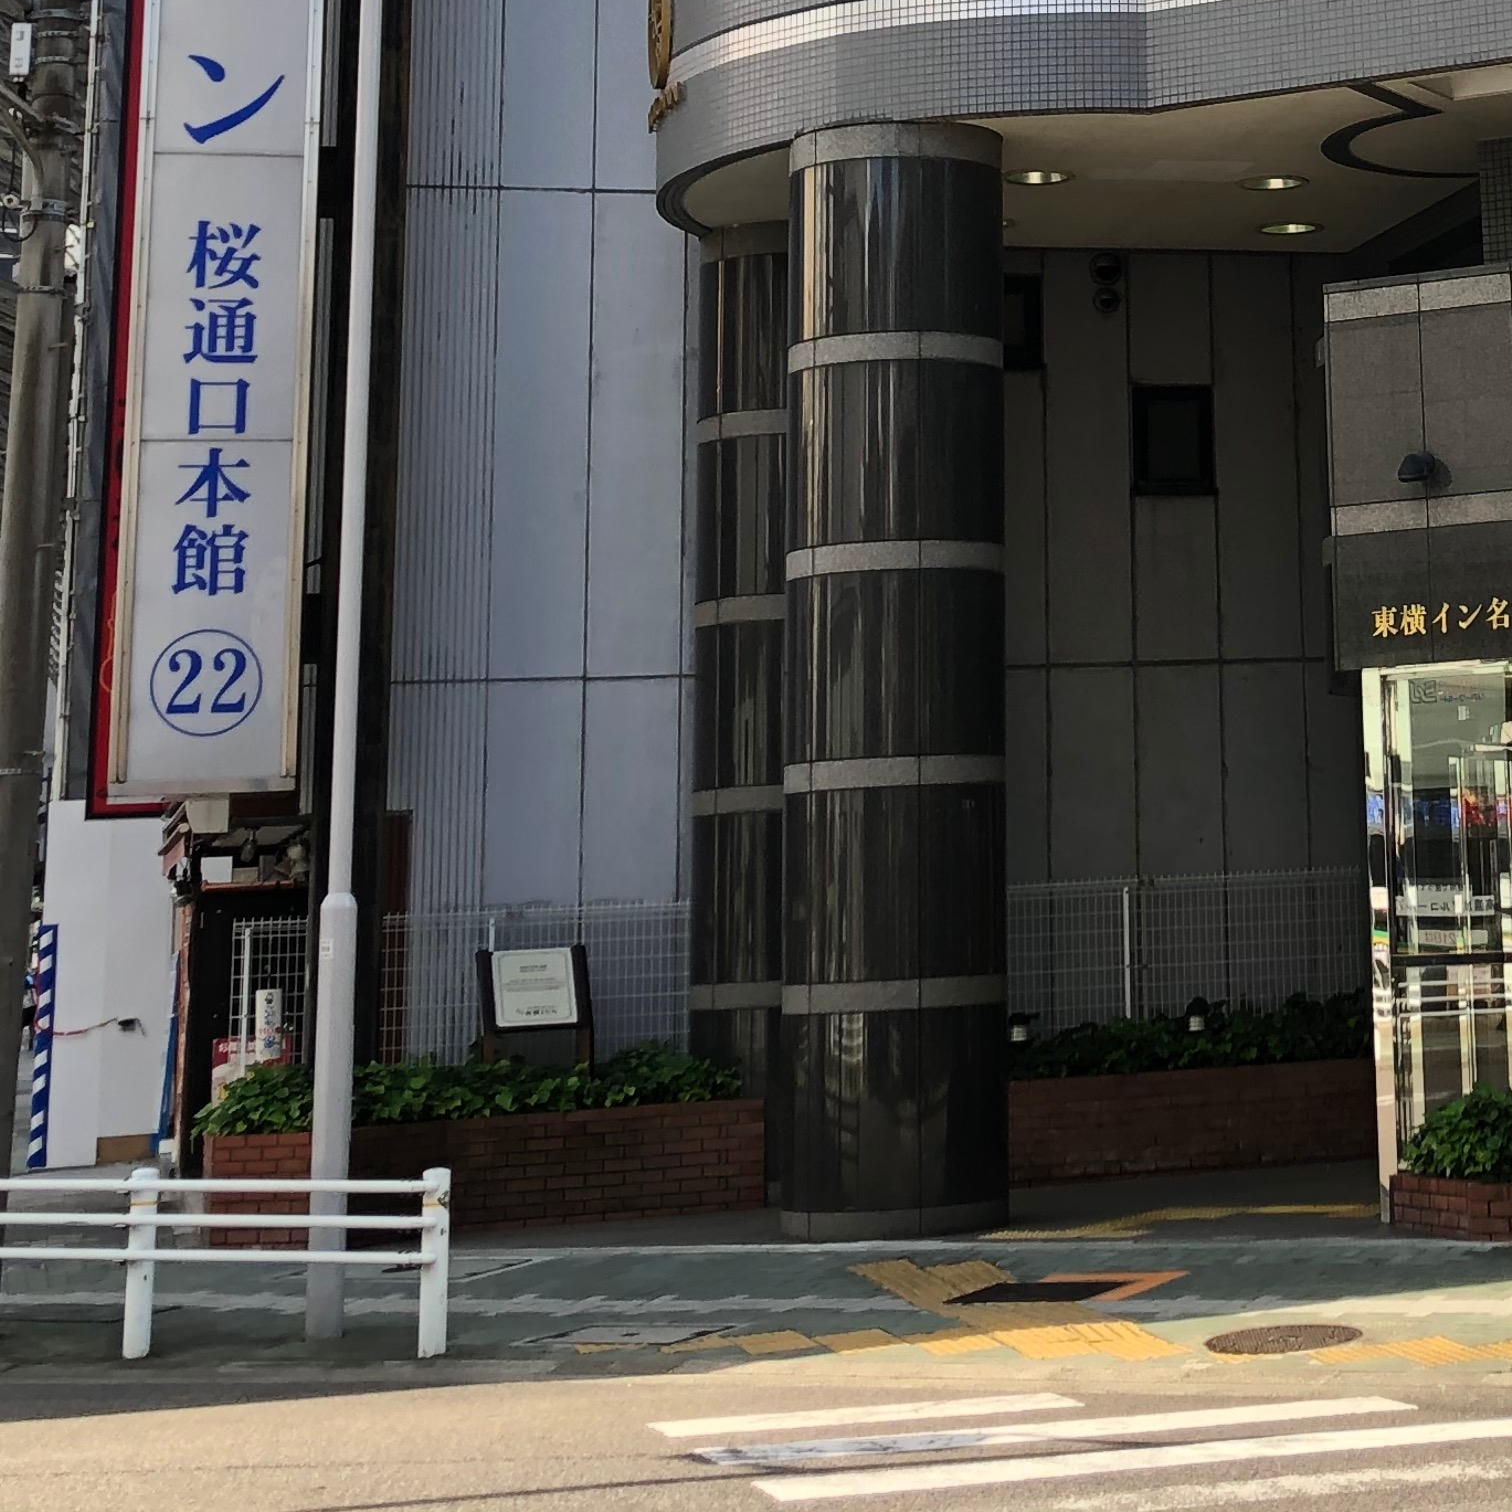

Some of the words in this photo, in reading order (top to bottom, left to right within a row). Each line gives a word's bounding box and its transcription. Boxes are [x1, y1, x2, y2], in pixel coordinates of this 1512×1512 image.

[171, 219, 262, 597] 桜通口本館
[161, 645, 251, 718] 22
